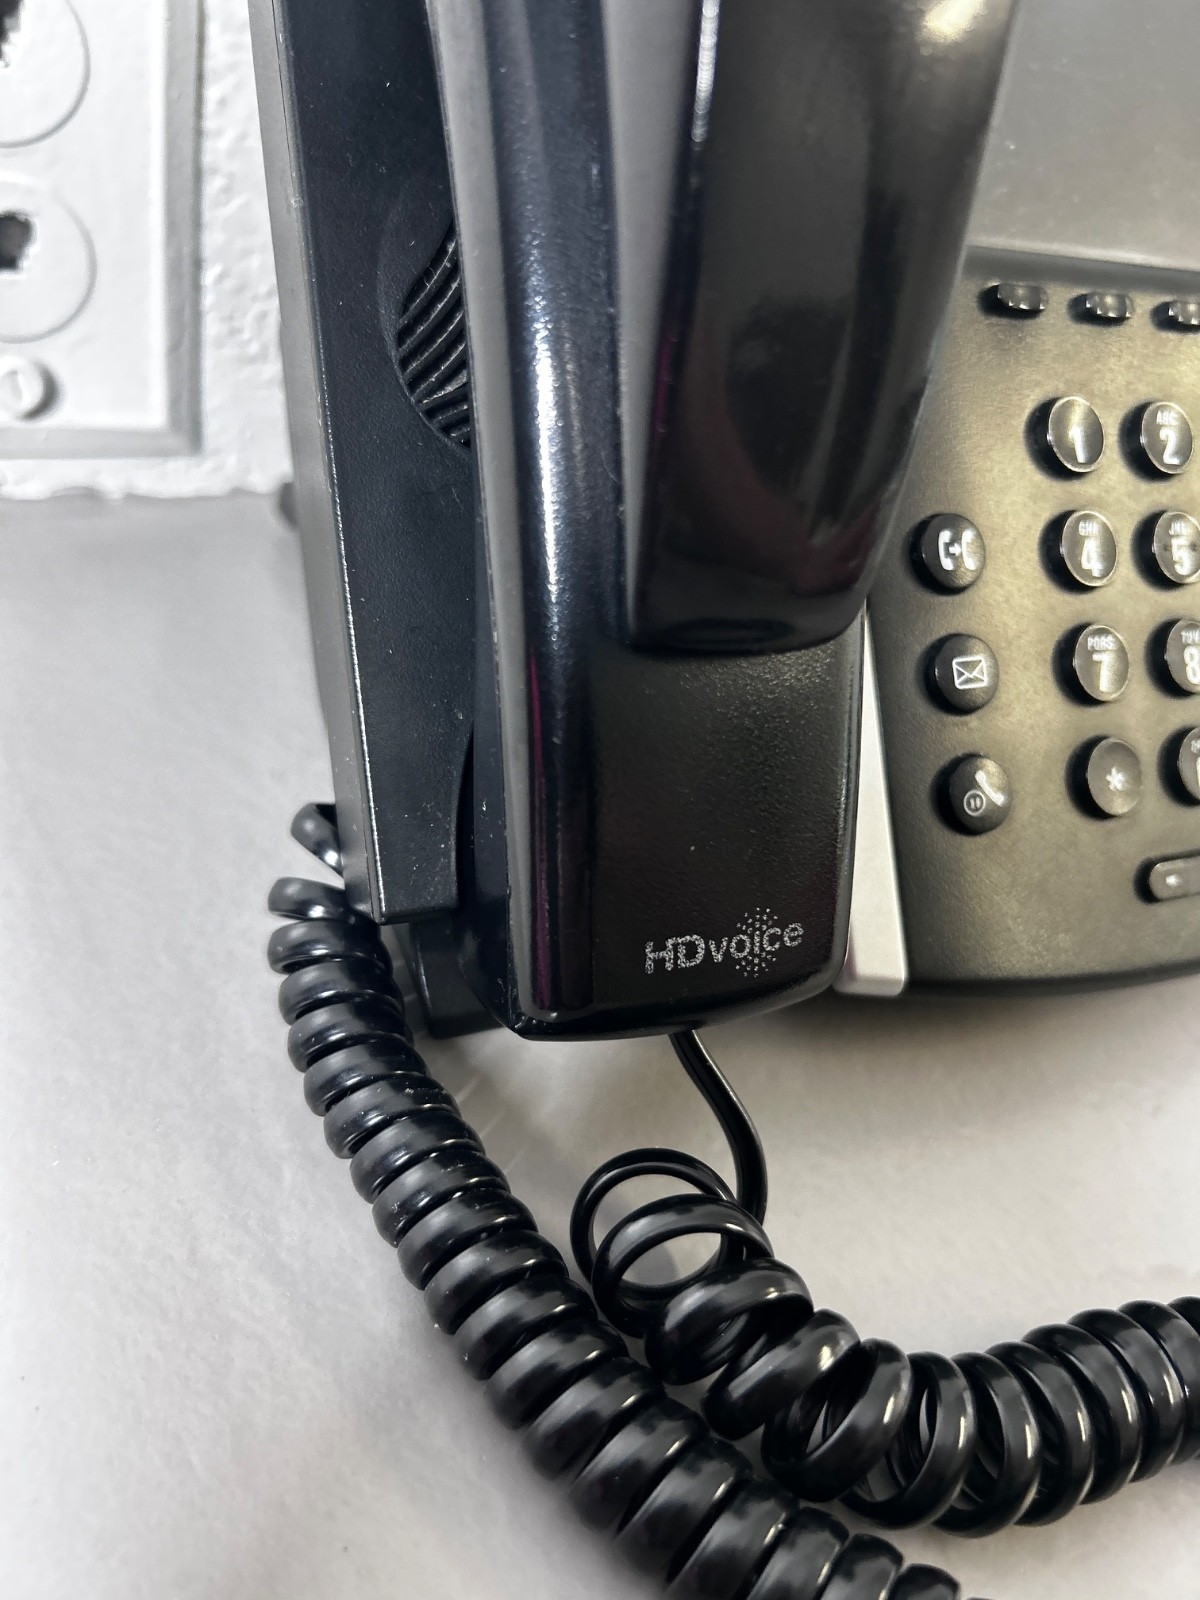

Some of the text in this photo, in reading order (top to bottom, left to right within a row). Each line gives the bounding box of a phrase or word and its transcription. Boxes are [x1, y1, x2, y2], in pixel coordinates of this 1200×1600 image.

[1068, 424, 1087, 463] 1
[1159, 426, 1181, 465] 2
[1078, 520, 1099, 536] GHI
[1080, 538, 1104, 577] 4
[1171, 536, 1193, 576] 5
[1092, 651, 1113, 692] 7
